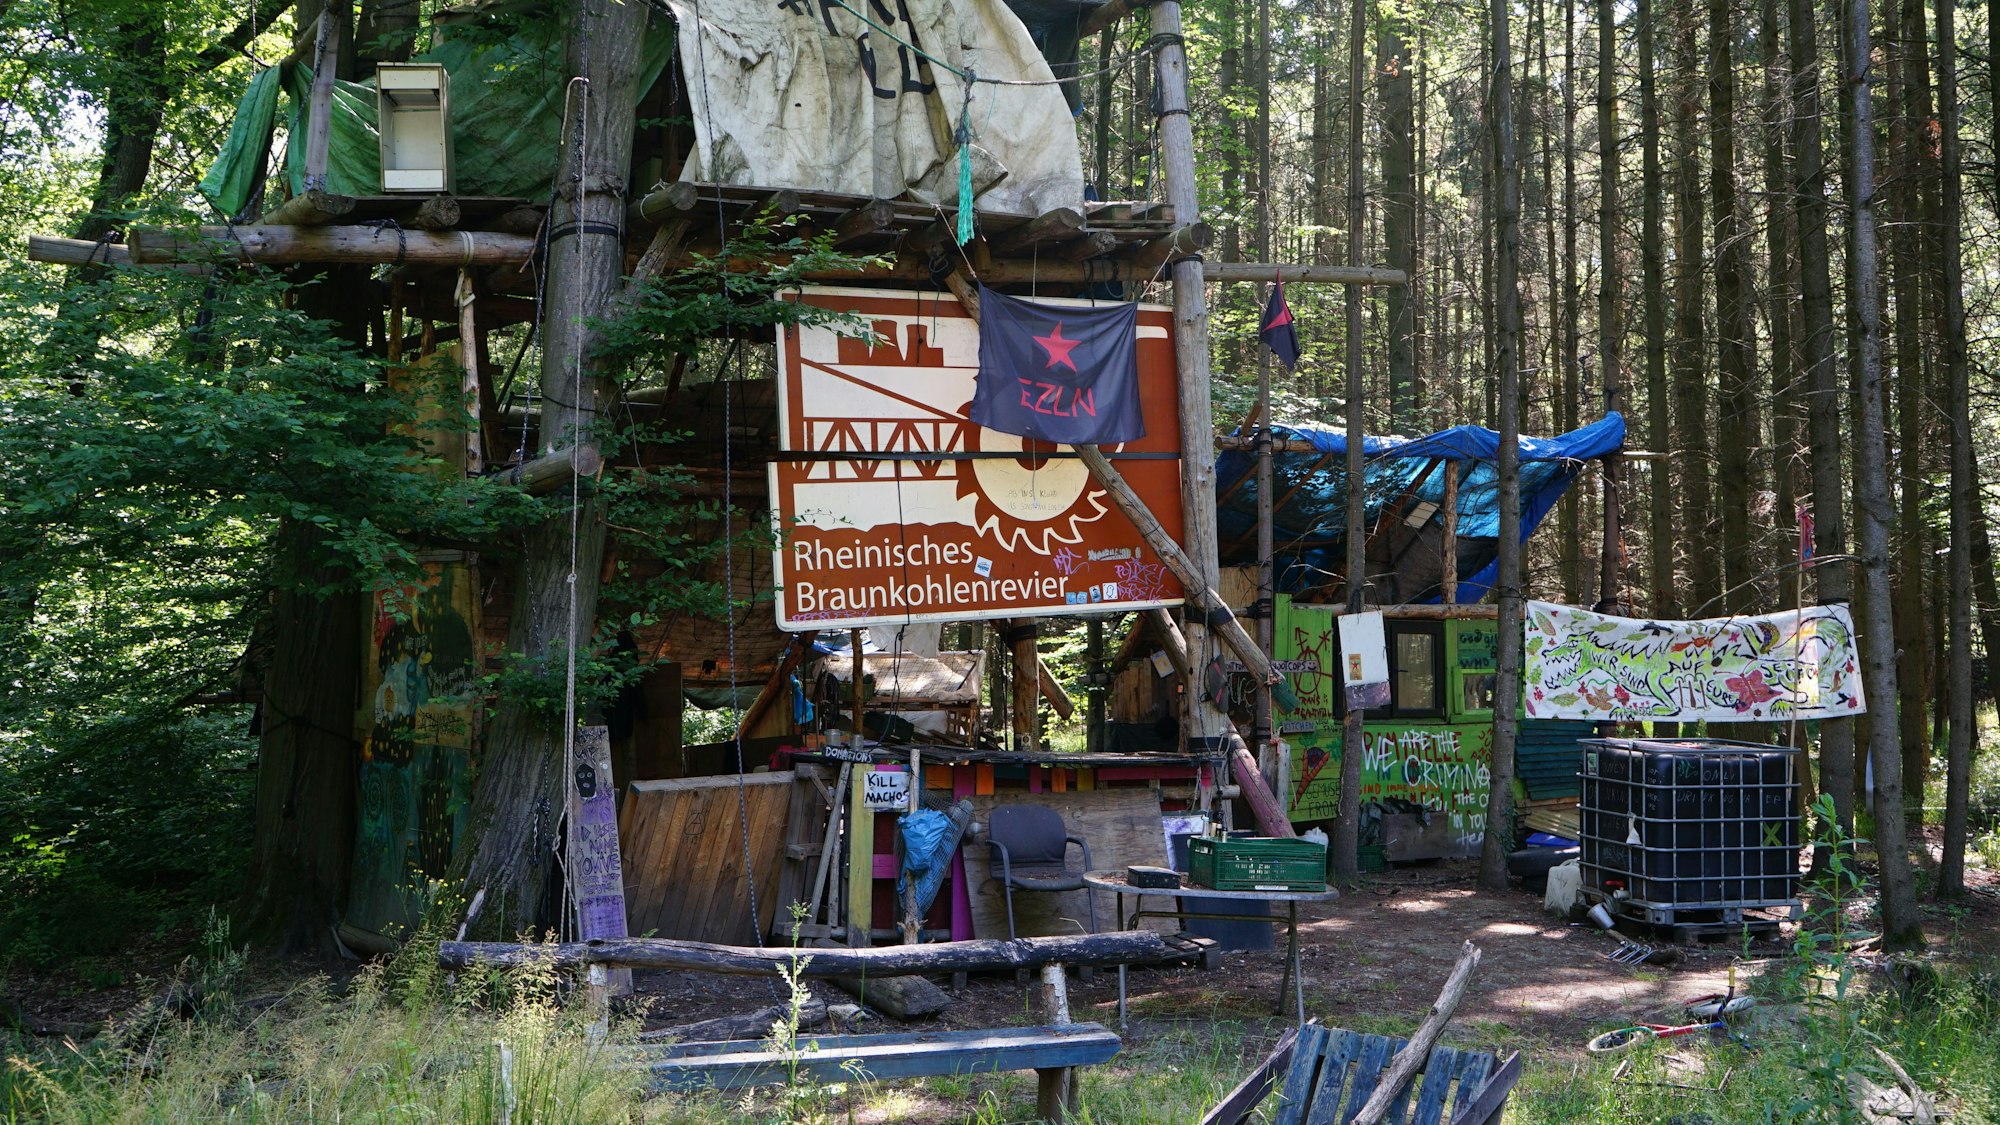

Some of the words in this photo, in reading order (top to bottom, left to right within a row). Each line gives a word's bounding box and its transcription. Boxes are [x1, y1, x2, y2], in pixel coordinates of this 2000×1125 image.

[1018, 377, 1097, 417] EZLN
[794, 534, 974, 572] Rheinisches
[796, 571, 1069, 613] Braunkohlenrevier
[1592, 651, 1618, 671] WIR
[1620, 665, 1646, 690] SIND
[1667, 660, 1706, 674] AUF
[1283, 721, 1315, 732] KITCHEN
[825, 746, 873, 763] DONATIONS
[1361, 735, 1398, 772] WE
[1398, 729, 1431, 750] ARE
[1431, 731, 1461, 753] THE
[867, 773, 897, 788] KILL
[1404, 754, 1491, 791] CRIMINA
[1309, 800, 1340, 819] FRON
[1454, 792, 1476, 806] THE
[1468, 812, 1488, 831] YOU
